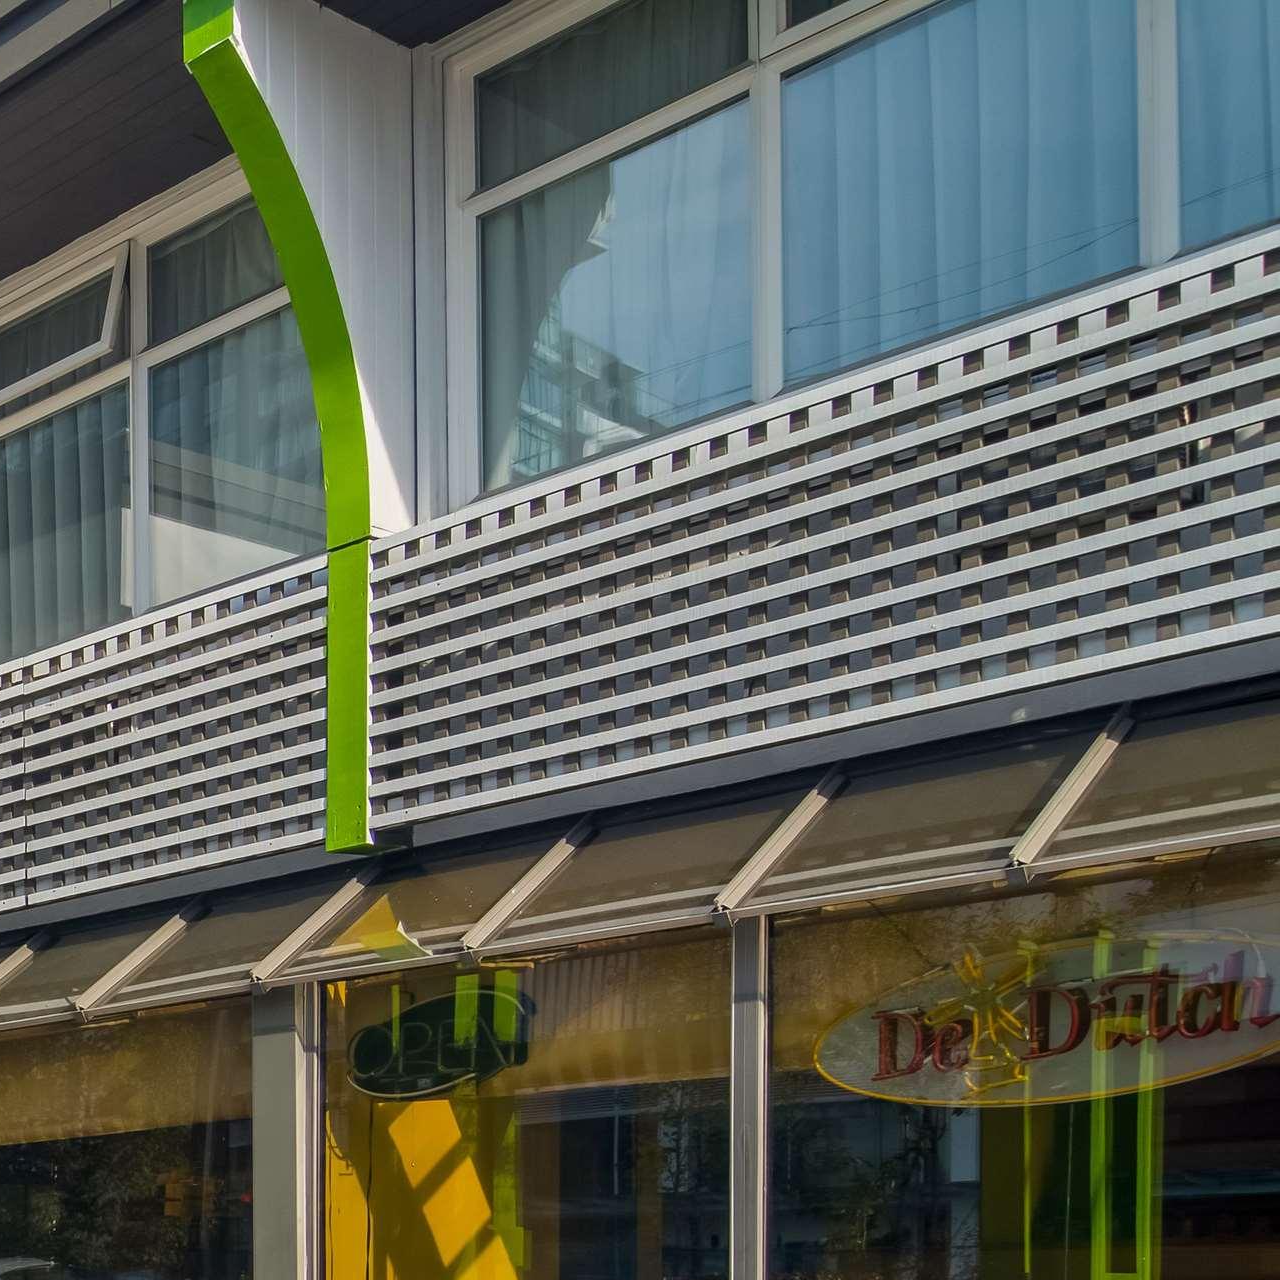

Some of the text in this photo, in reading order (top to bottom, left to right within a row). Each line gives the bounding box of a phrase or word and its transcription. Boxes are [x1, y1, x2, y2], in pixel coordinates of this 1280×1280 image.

[349, 1016, 518, 1079] OPEN
[871, 950, 1280, 1081] De Dutch
